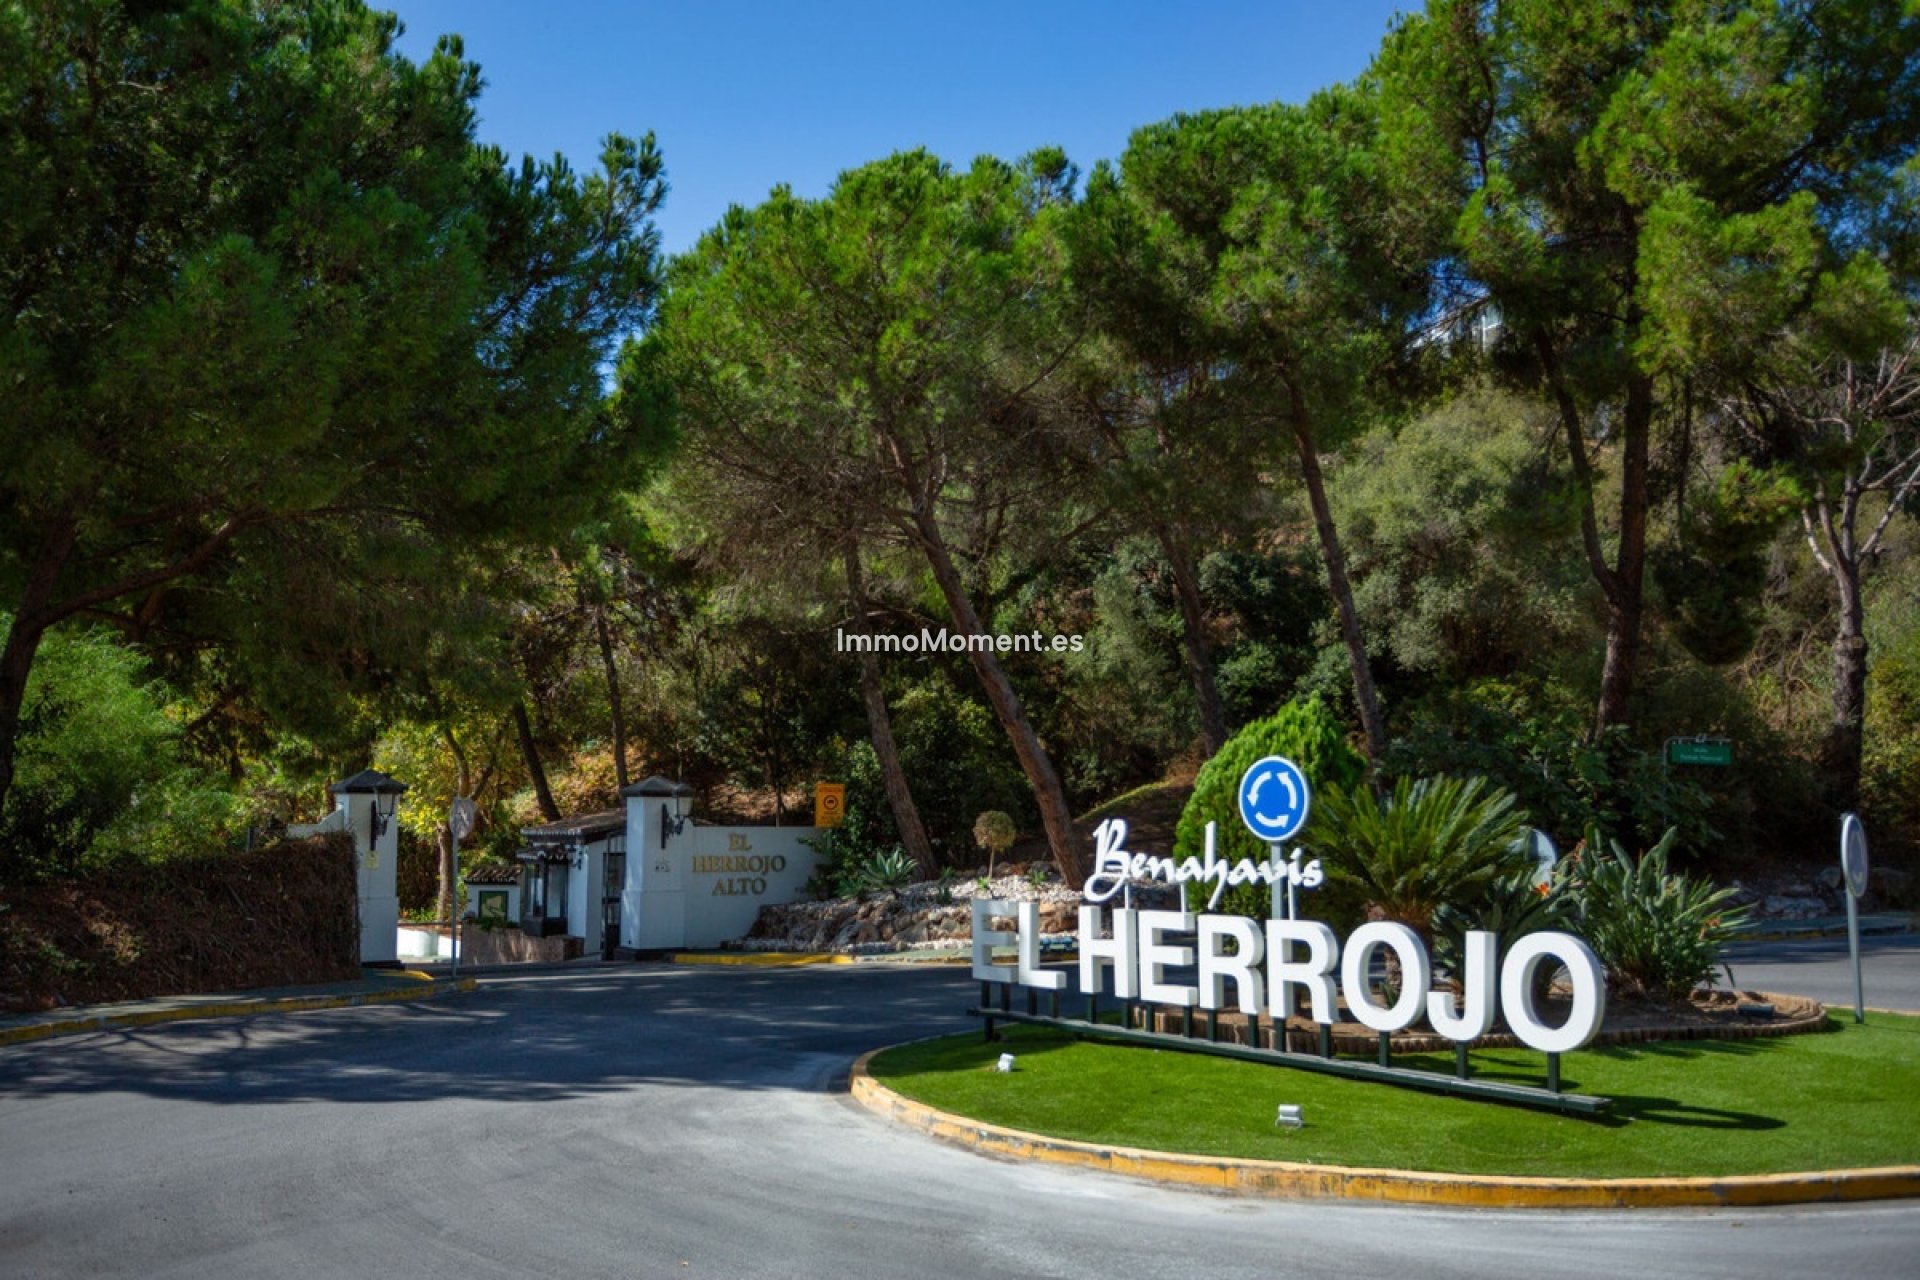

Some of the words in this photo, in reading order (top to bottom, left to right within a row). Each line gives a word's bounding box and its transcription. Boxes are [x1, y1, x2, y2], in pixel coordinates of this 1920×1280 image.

[729, 833, 753, 852] EL
[692, 854, 786, 875] HERROJO
[713, 878, 767, 896] ALTO
[970, 899, 1067, 991] EL
[1078, 905, 1606, 1053] HERROJO
